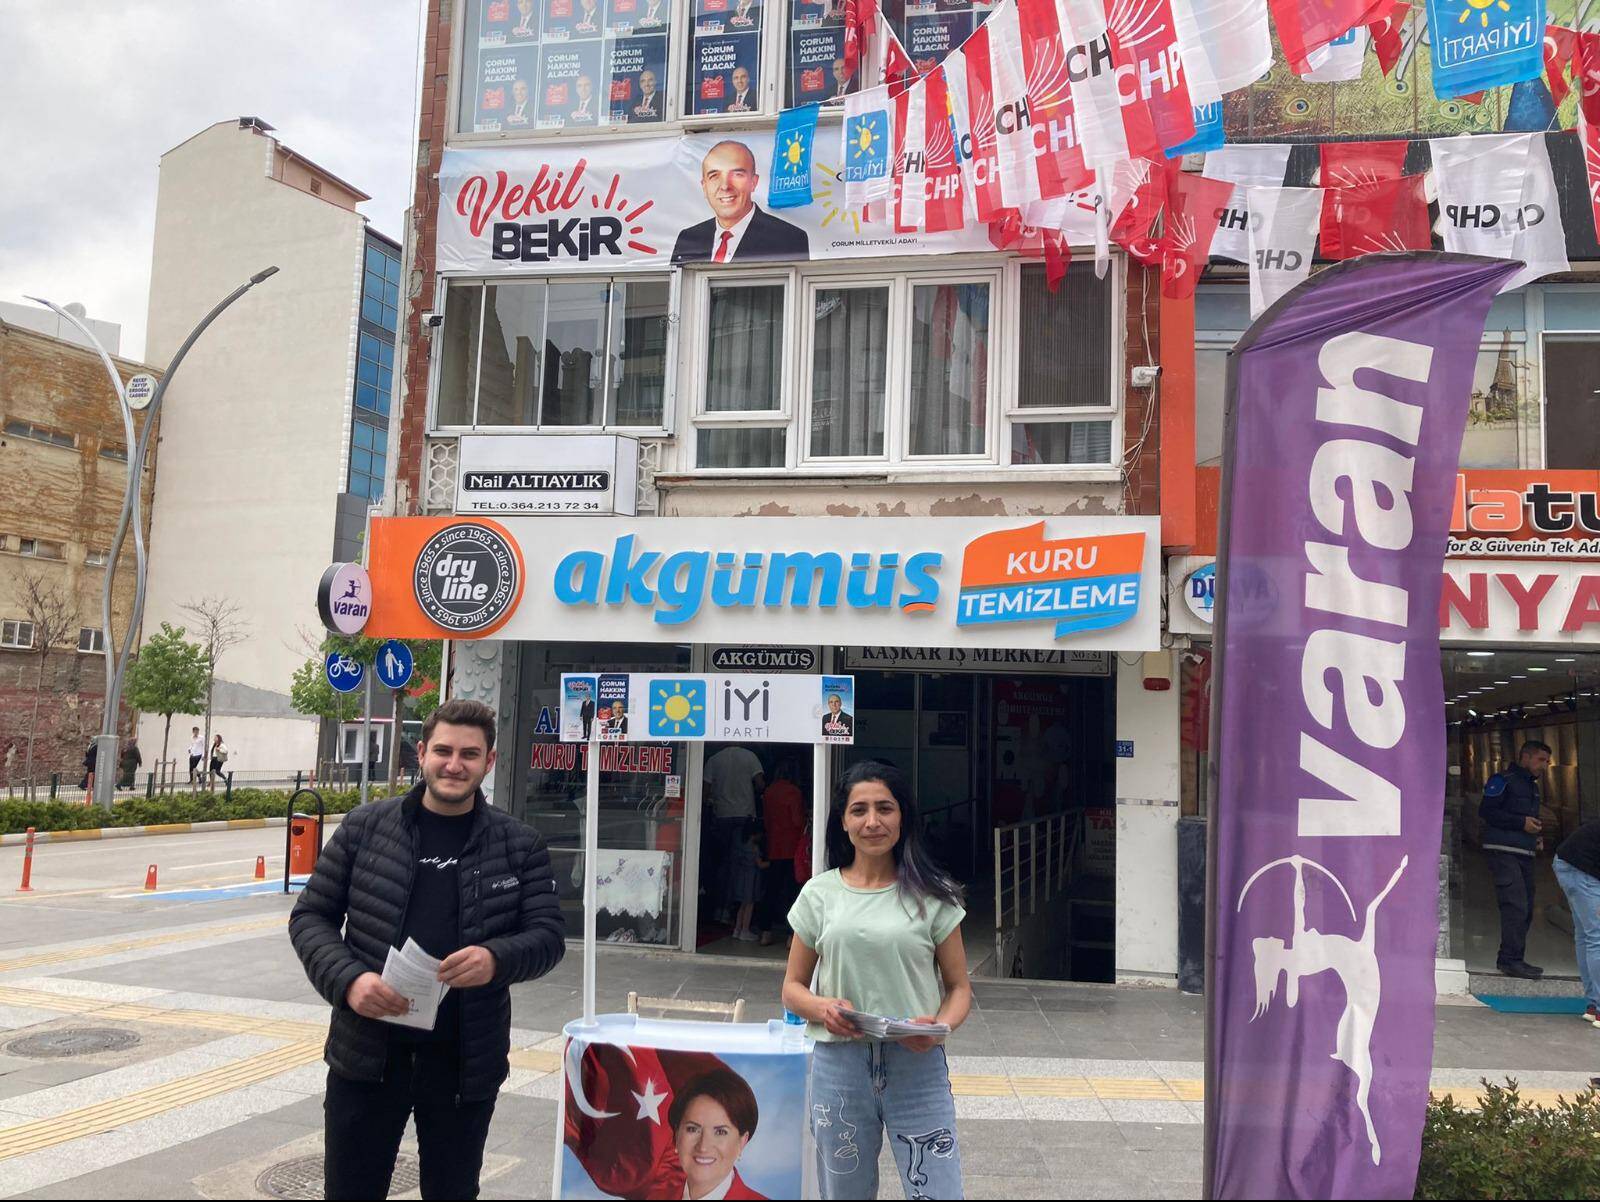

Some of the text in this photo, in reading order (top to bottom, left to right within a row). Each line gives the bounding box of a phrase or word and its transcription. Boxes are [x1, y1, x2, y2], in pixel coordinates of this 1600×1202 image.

[913, 27, 948, 36] ÇORUM
[913, 35, 951, 44] HAKKINI
[702, 46, 734, 55] ÇORUM
[800, 36, 833, 47] ÇORUM
[800, 45, 836, 55] HAKKINI
[913, 42, 950, 52] ALACAK
[701, 54, 736, 62] HAKKINI
[701, 62, 736, 71] ALACAK
[800, 53, 836, 63] ALACAK
[1115, 41, 1183, 106] CHP
[995, 94, 1032, 135] CH
[924, 173, 960, 201] CHP
[456, 158, 587, 238] Vekil
[492, 216, 623, 262] BEKİR
[470, 474, 602, 488] Nail ALTIAYLIK
[472, 502, 560, 510] TEL:0.364.213
[440, 529, 494, 546] since 1965
[1470, 541, 1482, 552] &
[1486, 541, 1546, 553] Güvenin
[1551, 541, 1574, 553] Tek
[436, 554, 476, 583] dry
[1006, 545, 1099, 576] KURU
[419, 548, 436, 604] since 1965
[494, 550, 510, 606] since 1965
[554, 533, 944, 626] akgümüş
[1298, 331, 1435, 837] varan
[441, 576, 488, 600] line
[333, 599, 368, 618] varan
[960, 581, 1137, 619] TEMİZLEME
[436, 609, 488, 626] since 1965
[716, 650, 812, 668] AKGÜMÜŞ
[724, 680, 770, 722] İYİ
[724, 727, 770, 738] PARTİ
[530, 741, 672, 774] KURU TMİZLEME
